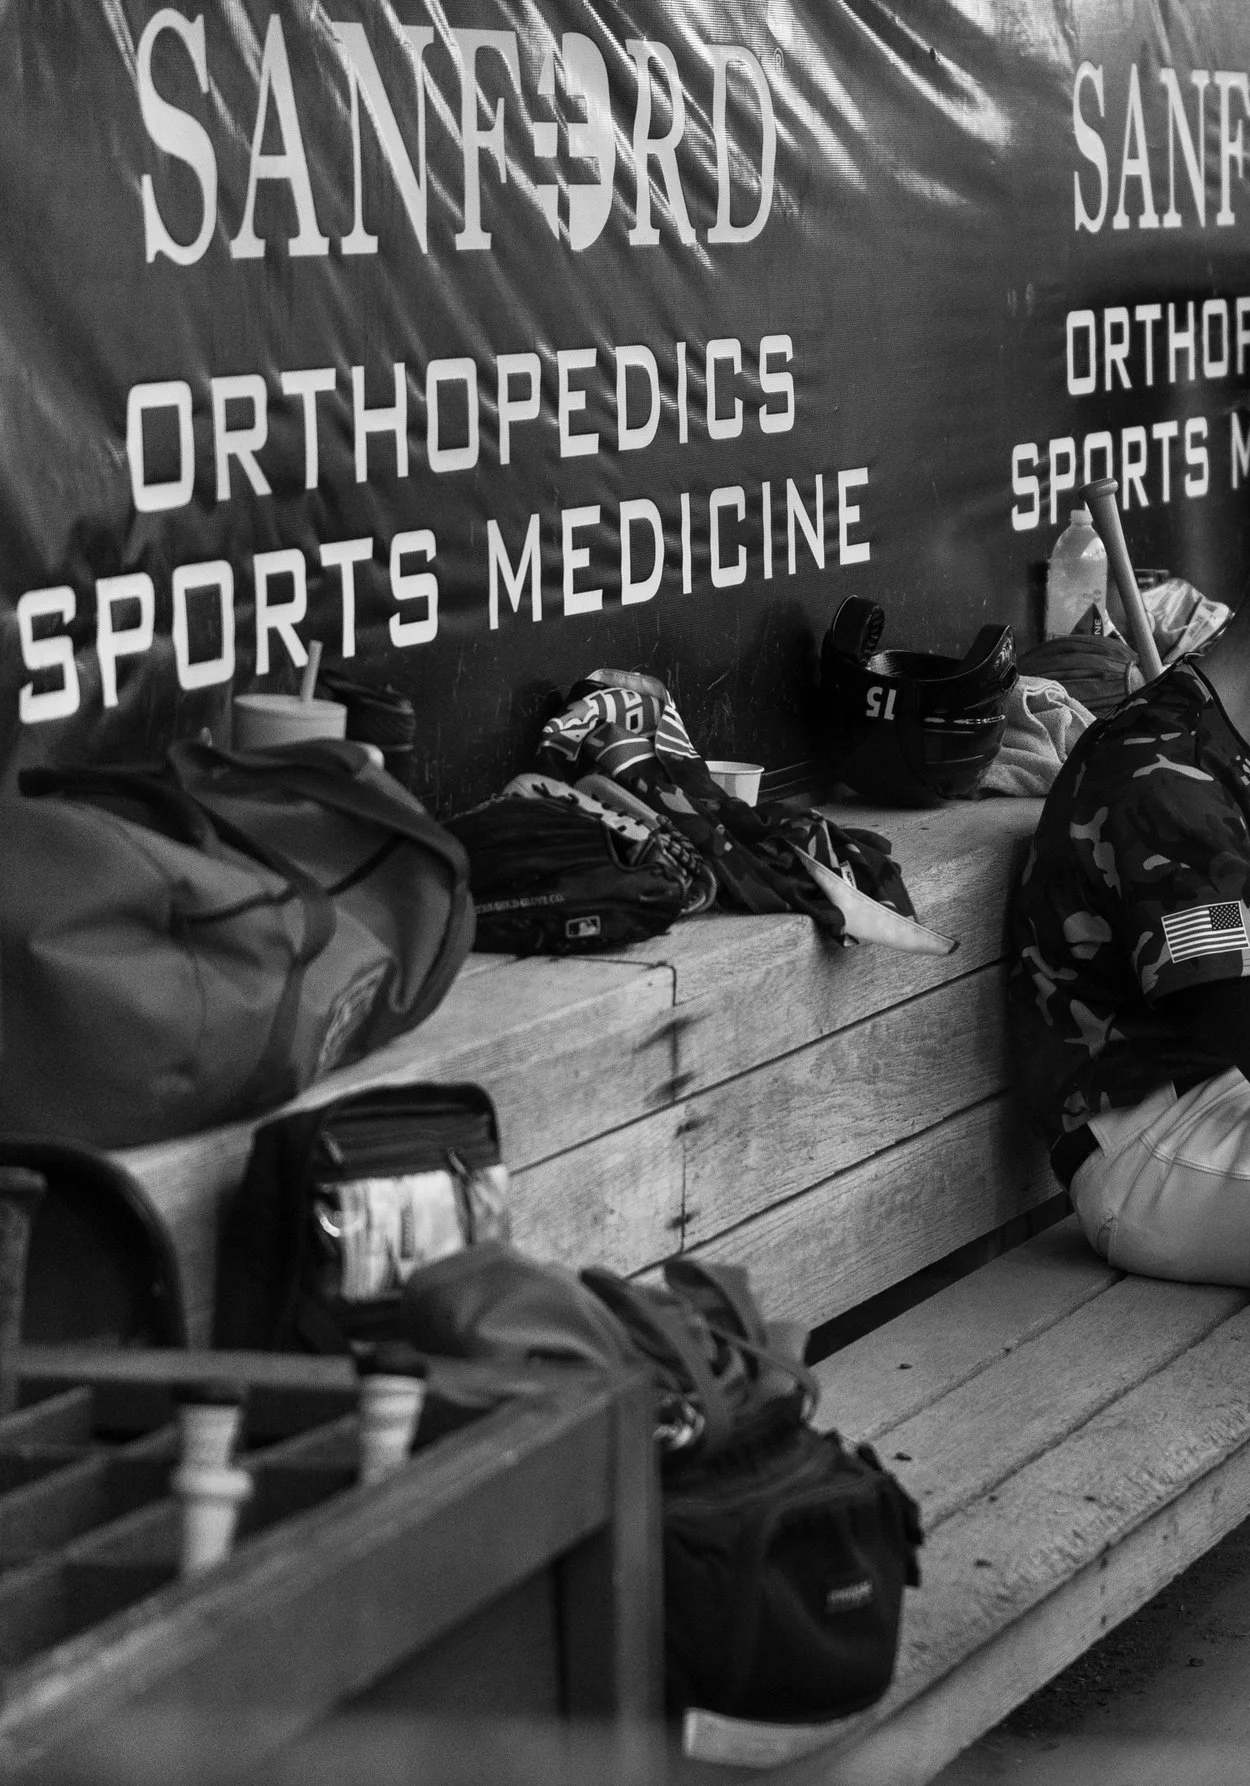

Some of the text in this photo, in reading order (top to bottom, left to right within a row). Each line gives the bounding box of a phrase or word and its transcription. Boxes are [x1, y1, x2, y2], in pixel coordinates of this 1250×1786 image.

[137, 7, 776, 266] SANFORD
[127, 335, 795, 514] ORTHOPEDICS
[1011, 415, 1209, 531] SPORTS
[16, 467, 871, 724] SPORTS MEDICINE
[866, 686, 897, 720] 15
